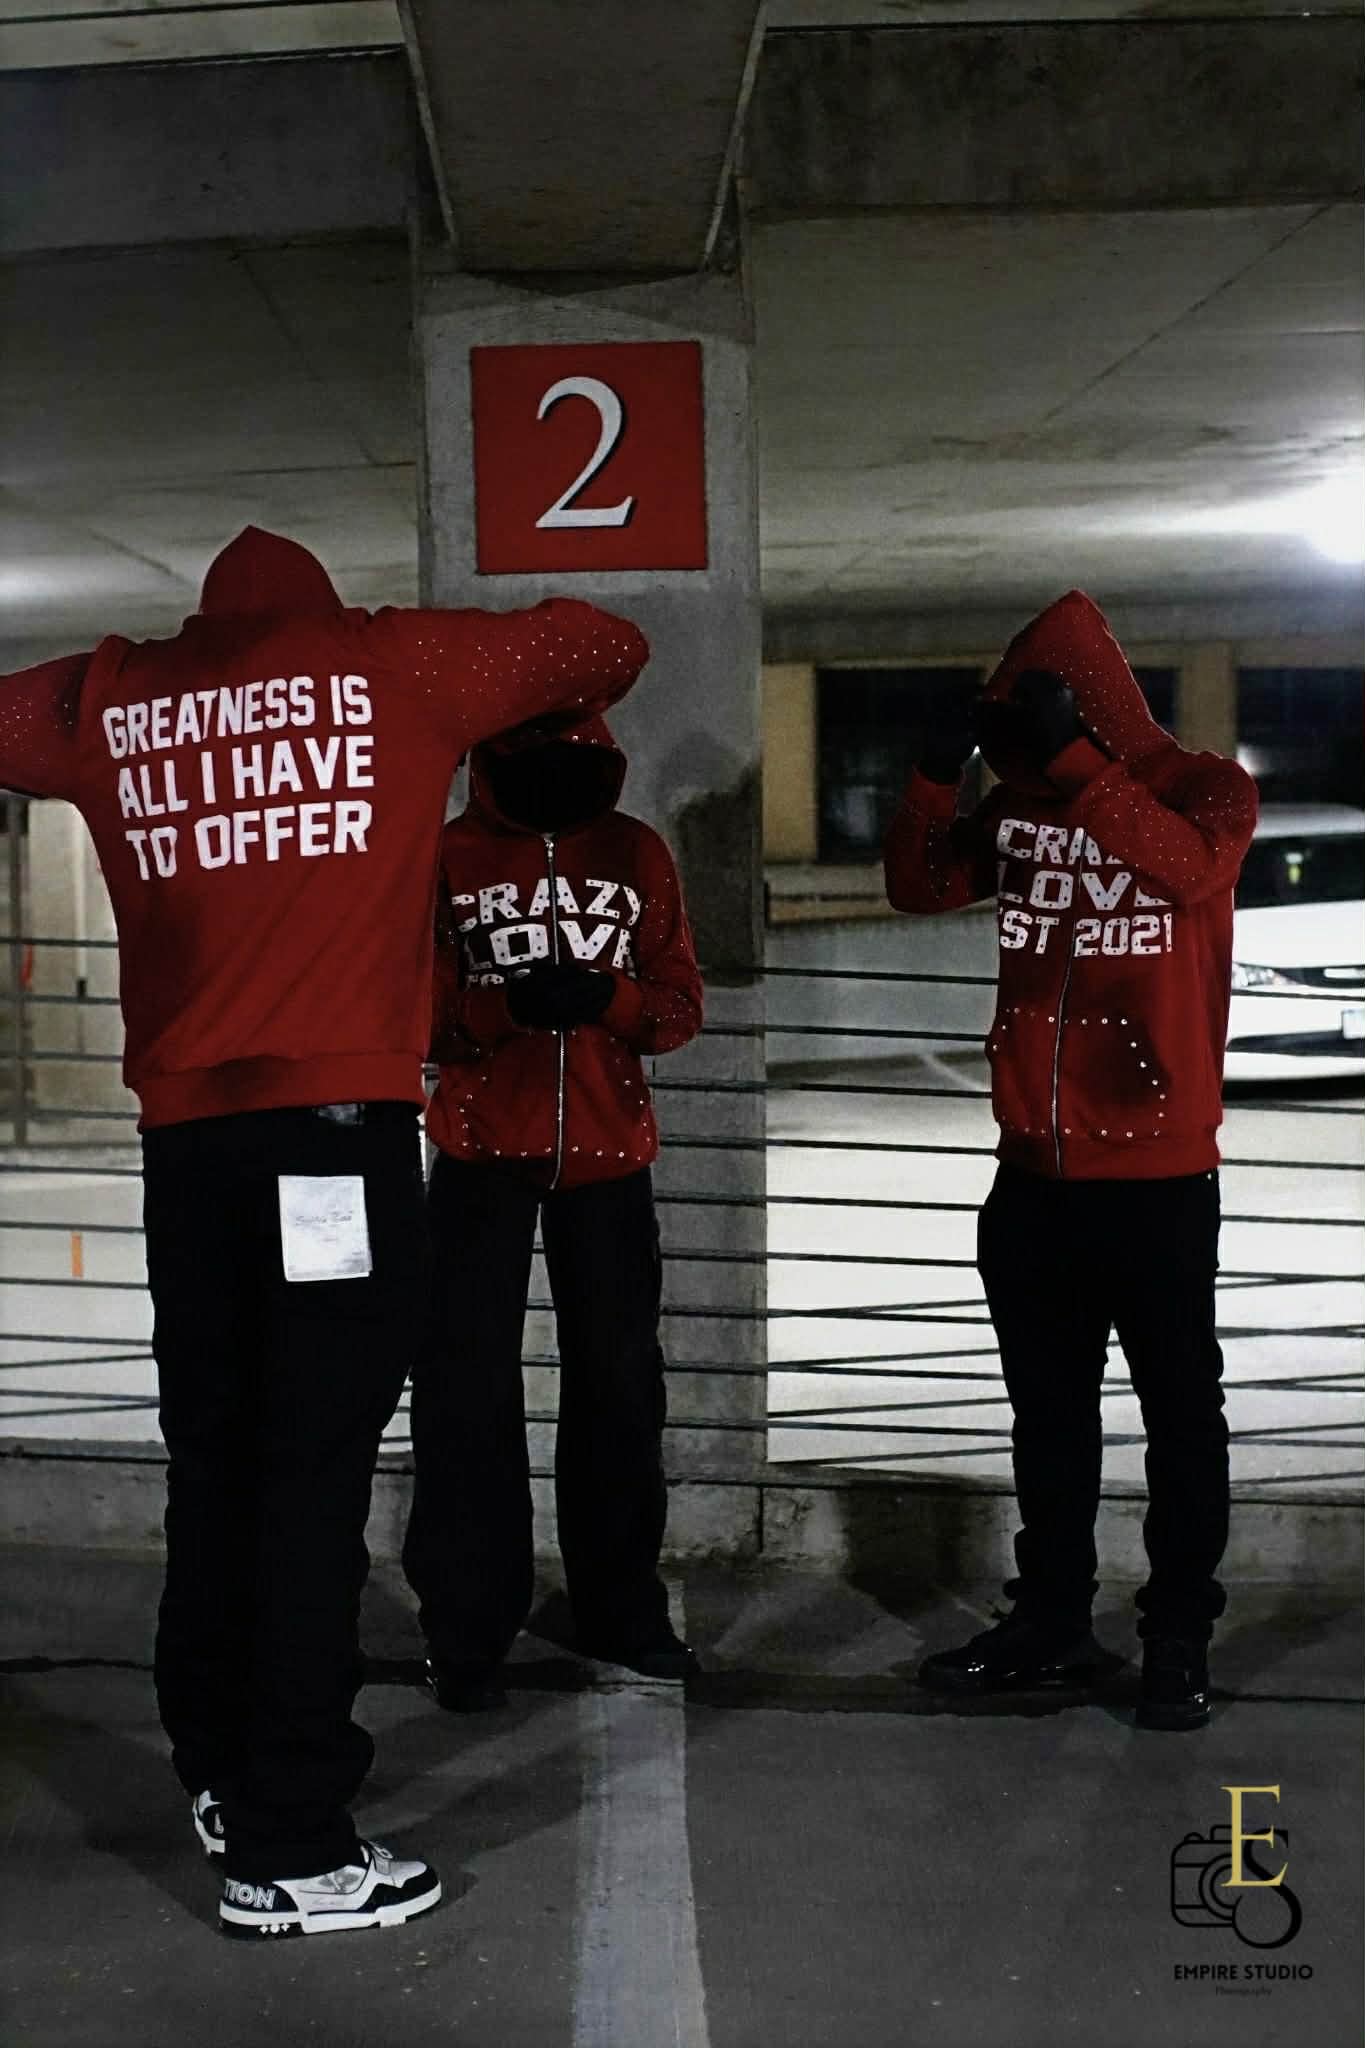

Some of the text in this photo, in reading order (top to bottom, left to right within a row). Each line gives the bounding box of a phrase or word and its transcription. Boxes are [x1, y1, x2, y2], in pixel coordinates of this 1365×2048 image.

[535, 376, 633, 528] 2
[102, 675, 373, 759] GREATNESS IS
[118, 736, 374, 818] ALL I HAVE
[125, 800, 373, 880] TO OFFER
[1073, 912, 1173, 957] 2021
